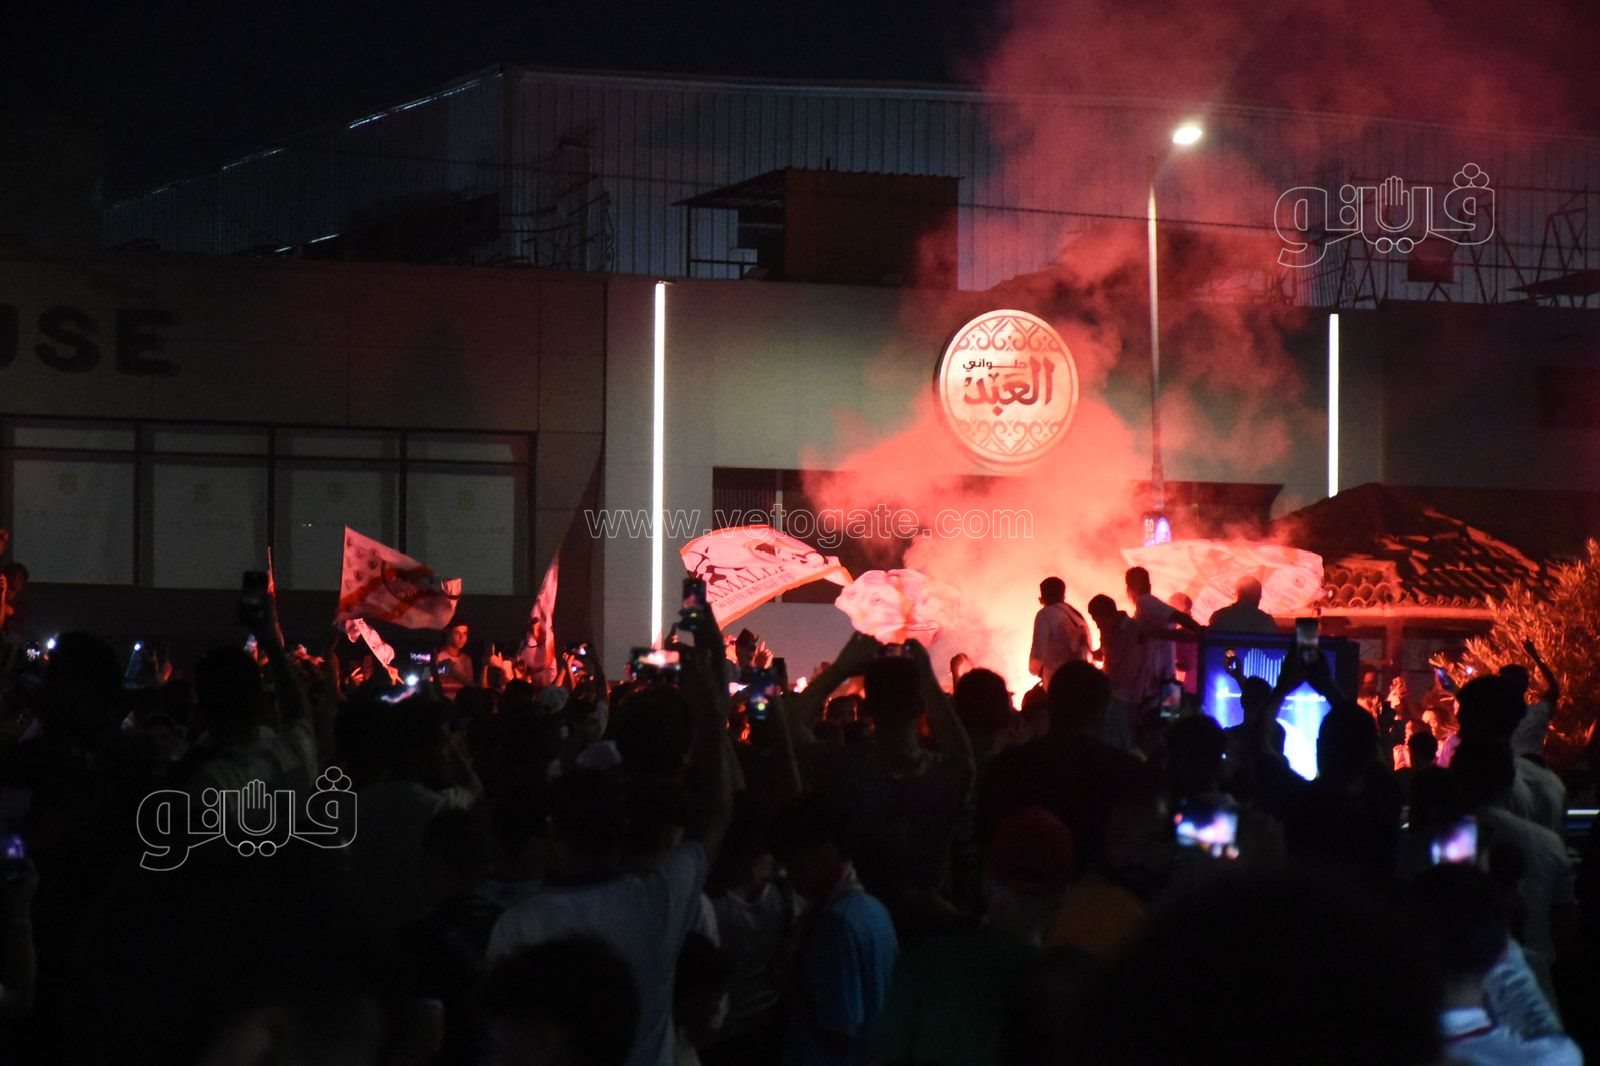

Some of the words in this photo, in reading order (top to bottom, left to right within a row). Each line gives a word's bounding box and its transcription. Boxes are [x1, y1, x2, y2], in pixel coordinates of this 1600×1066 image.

[0, 303, 181, 376] SE
[962, 358, 1028, 372] حلواني
[962, 355, 1056, 416] العبد
